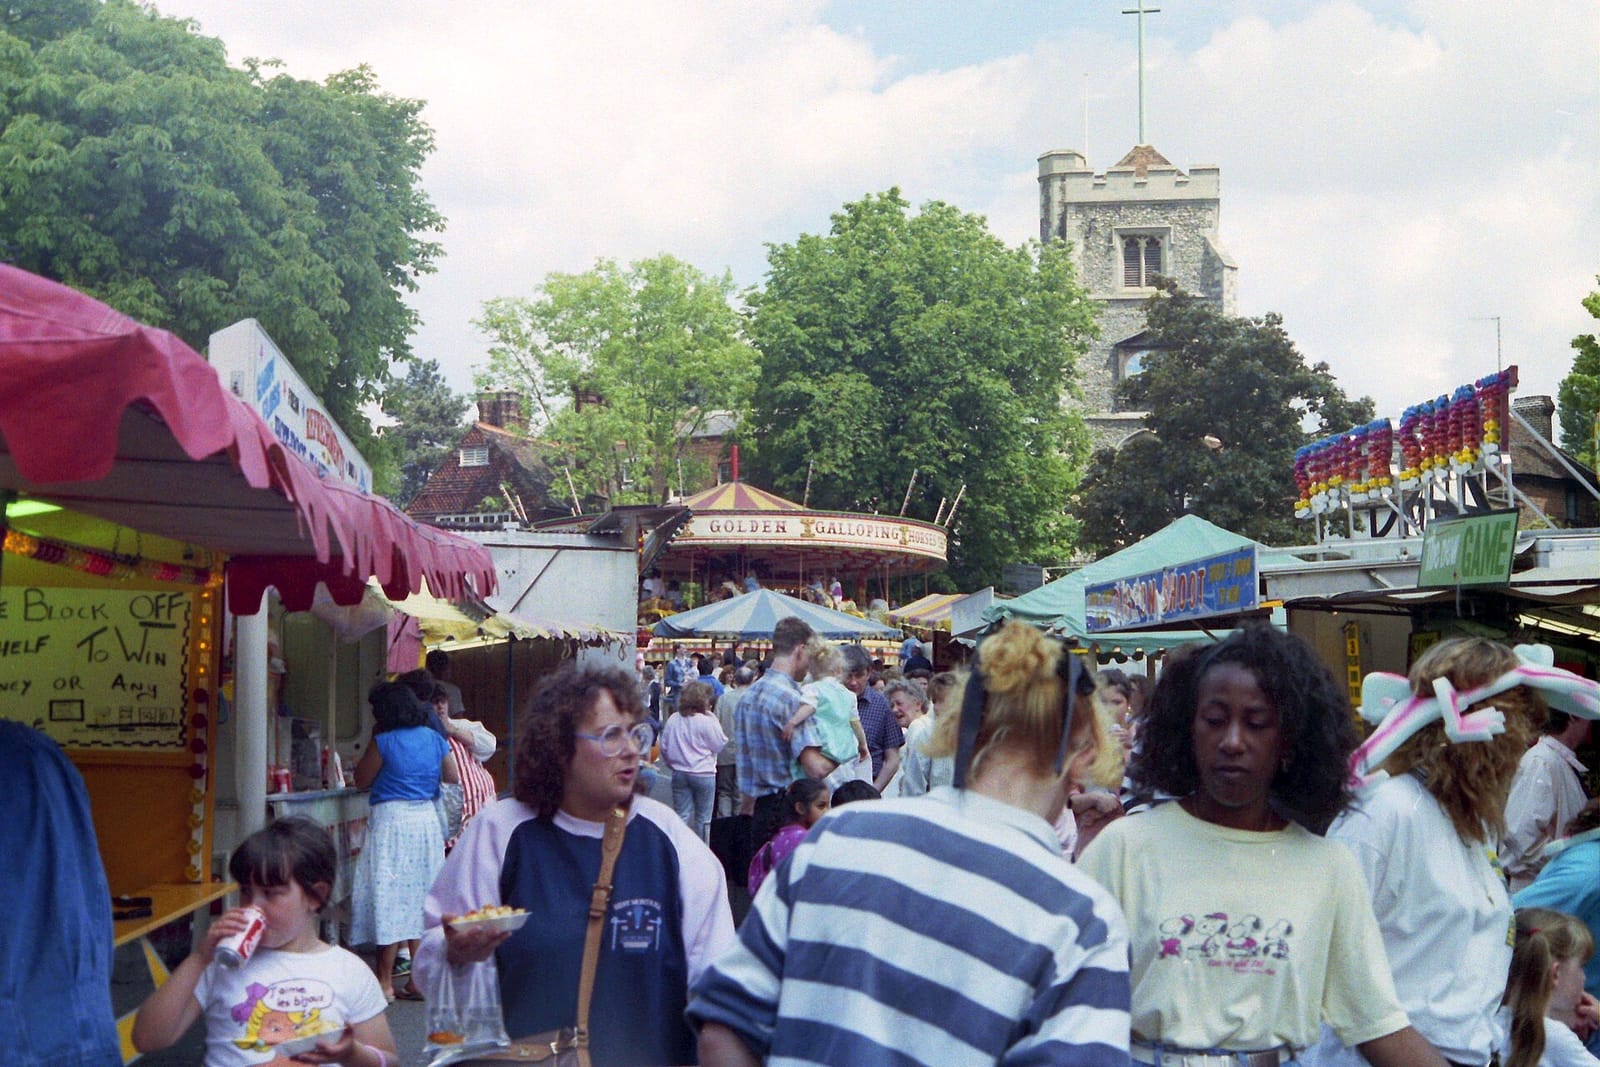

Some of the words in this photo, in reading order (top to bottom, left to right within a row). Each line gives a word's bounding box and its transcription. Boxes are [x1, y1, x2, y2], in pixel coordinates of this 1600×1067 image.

[709, 519, 787, 533] GOLDEN
[815, 520, 899, 540] GALLOPING
[908, 529, 937, 547] HORSES
[1461, 520, 1512, 577] GAME
[1162, 567, 1206, 614] SHOOT
[129, 591, 184, 621] OFF
[53, 675, 85, 691] OR
